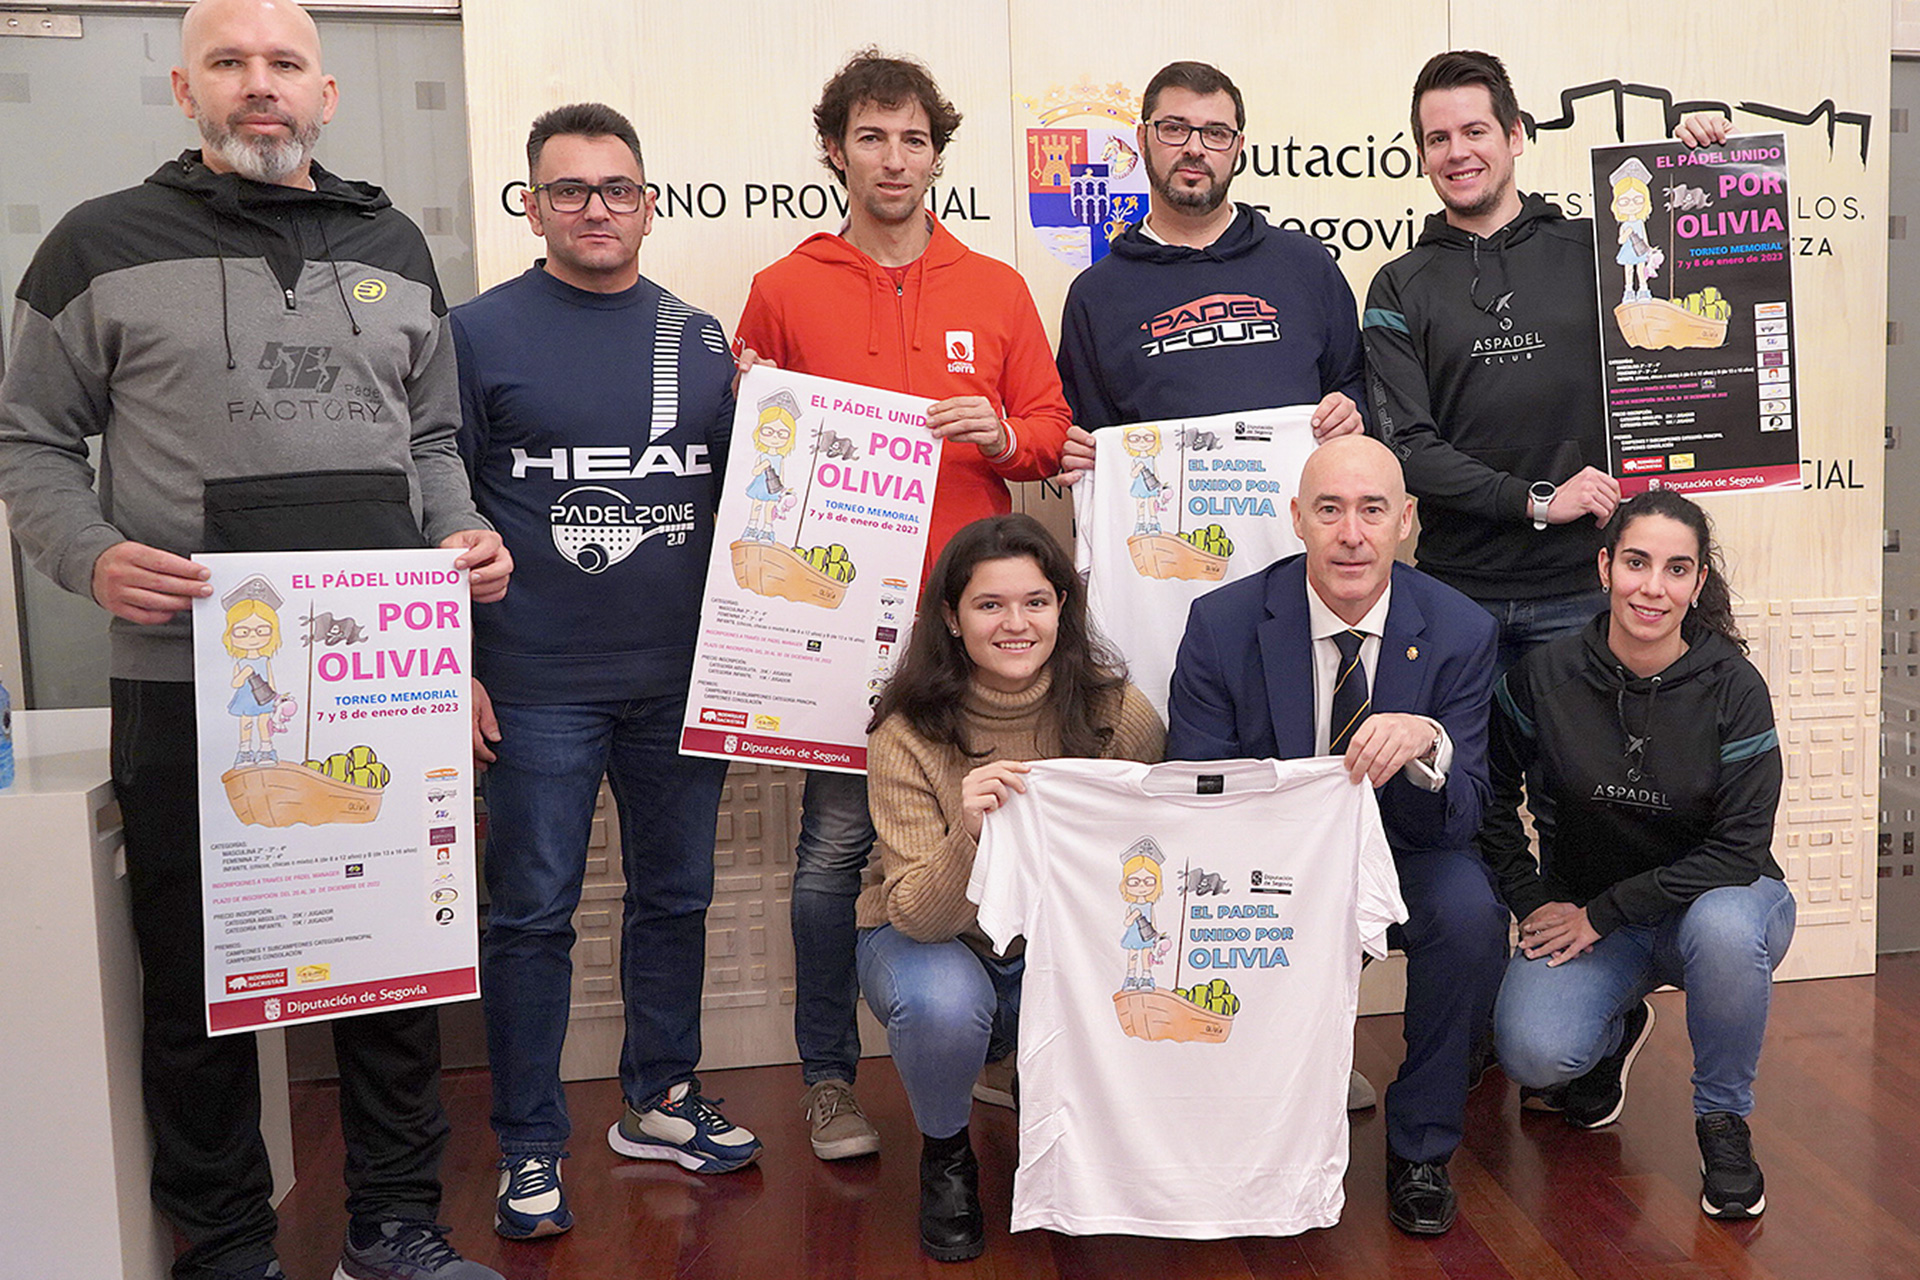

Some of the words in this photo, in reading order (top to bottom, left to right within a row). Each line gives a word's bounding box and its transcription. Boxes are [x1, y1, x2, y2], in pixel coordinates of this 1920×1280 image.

[1233, 132, 1424, 178] utació
[1656, 156, 1674, 168] EL
[1678, 150, 1727, 166] PÁDEL
[1730, 147, 1780, 162] UNIDO
[1718, 172, 1783, 198] POR
[501, 181, 726, 218] GRNO
[745, 183, 991, 220] PROVIAL
[1252, 205, 1414, 261] govi
[1676, 207, 1785, 239] OLIVIA
[1689, 246, 1728, 257] TORNEO
[1730, 242, 1783, 254] MEMORIAL
[1678, 260, 1683, 268] 7
[1685, 260, 1692, 270] y
[1703, 258, 1714, 267] de
[1717, 256, 1744, 266] enero
[1746, 254, 1758, 264] de
[1761, 253, 1783, 263] 2023
[1151, 300, 1277, 334] PADEL
[1158, 322, 1278, 356] FOUR
[1473, 332, 1543, 352] ASPADEL
[1485, 353, 1532, 365] CLUB
[227, 399, 383, 423] FACTORY
[811, 394, 828, 409] EL
[833, 398, 883, 420] PÁDEL
[888, 410, 927, 427] UNID
[868, 432, 934, 466] POR
[1188, 459, 1209, 471] EL
[1212, 459, 1266, 473] PADEL
[817, 463, 926, 504] OLIVIA
[1188, 479, 1241, 492] UNIDO
[1245, 480, 1280, 494] POR
[1664, 478, 1713, 491] Diputación
[1715, 476, 1727, 487] de
[1729, 475, 1765, 488] Segovia
[550, 503, 695, 524] PADELZONE
[825, 499, 865, 514] TORNEO
[867, 506, 920, 523] MEMORIAL
[1188, 497, 1276, 518] OLIVIA
[810, 509, 816, 518] 7
[817, 512, 825, 521] y
[826, 511, 833, 520] 8
[836, 512, 848, 523] de
[850, 516, 879, 528] enero
[882, 518, 893, 530] de
[896, 522, 919, 535] 2023
[667, 532, 686, 547] 2.0
[292, 575, 315, 589] EL
[322, 570, 389, 588] PÁDEL
[395, 571, 460, 586] UNIDO
[379, 601, 461, 632] POR
[317, 647, 461, 682] OLIVIA
[335, 694, 387, 706] TORNEO
[391, 690, 458, 703] MEMORIAL
[316, 712, 324, 721] 7
[328, 713, 336, 724] y
[340, 710, 347, 720] 8
[351, 708, 367, 719] de
[371, 706, 408, 718] enero
[411, 705, 427, 716] de
[431, 703, 459, 714] 2023
[741, 740, 795, 758] Diputación
[797, 747, 811, 759] de
[813, 749, 850, 764] Segovia
[1593, 784, 1669, 806] ASPADEL
[1191, 905, 1213, 919] EL
[1217, 905, 1279, 919] PADEL
[1190, 928, 1252, 942] UNIDO
[1255, 927, 1294, 941] POR
[1188, 947, 1290, 969] OLIVIA
[286, 993, 357, 1014] Diputación
[360, 990, 376, 1003] de
[379, 984, 428, 1003] Segovia
